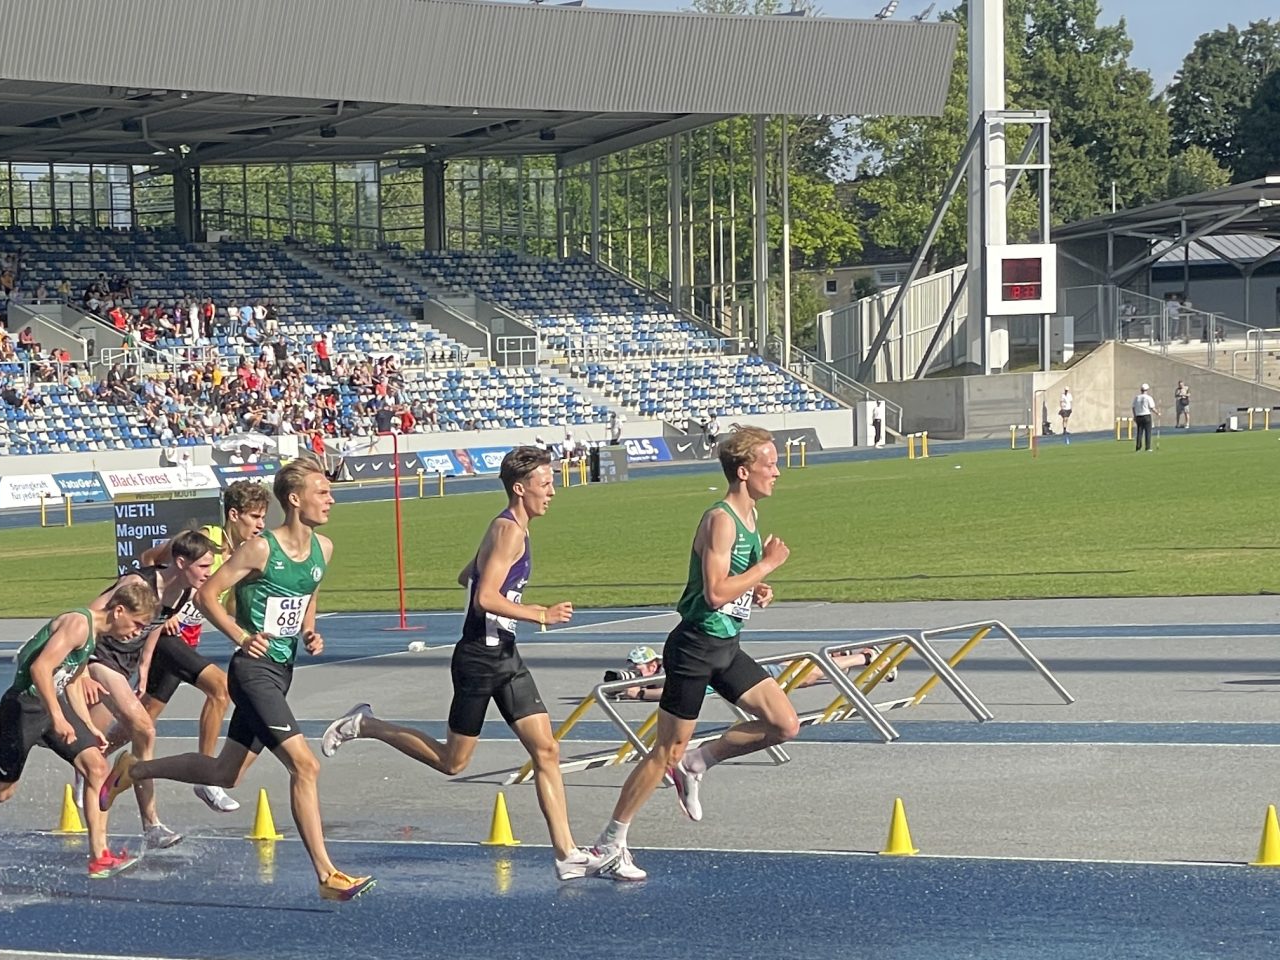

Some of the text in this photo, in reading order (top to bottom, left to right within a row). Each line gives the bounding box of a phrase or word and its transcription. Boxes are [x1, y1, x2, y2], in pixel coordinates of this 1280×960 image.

[624, 439, 659, 457] GLS.
[9, 480, 49, 494] Sprungkraft
[109, 471, 172, 488] Black Forest
[114, 502, 156, 518] VIETH
[116, 522, 168, 539] Magnus
[117, 541, 134, 557] NI
[280, 598, 303, 611] GLS
